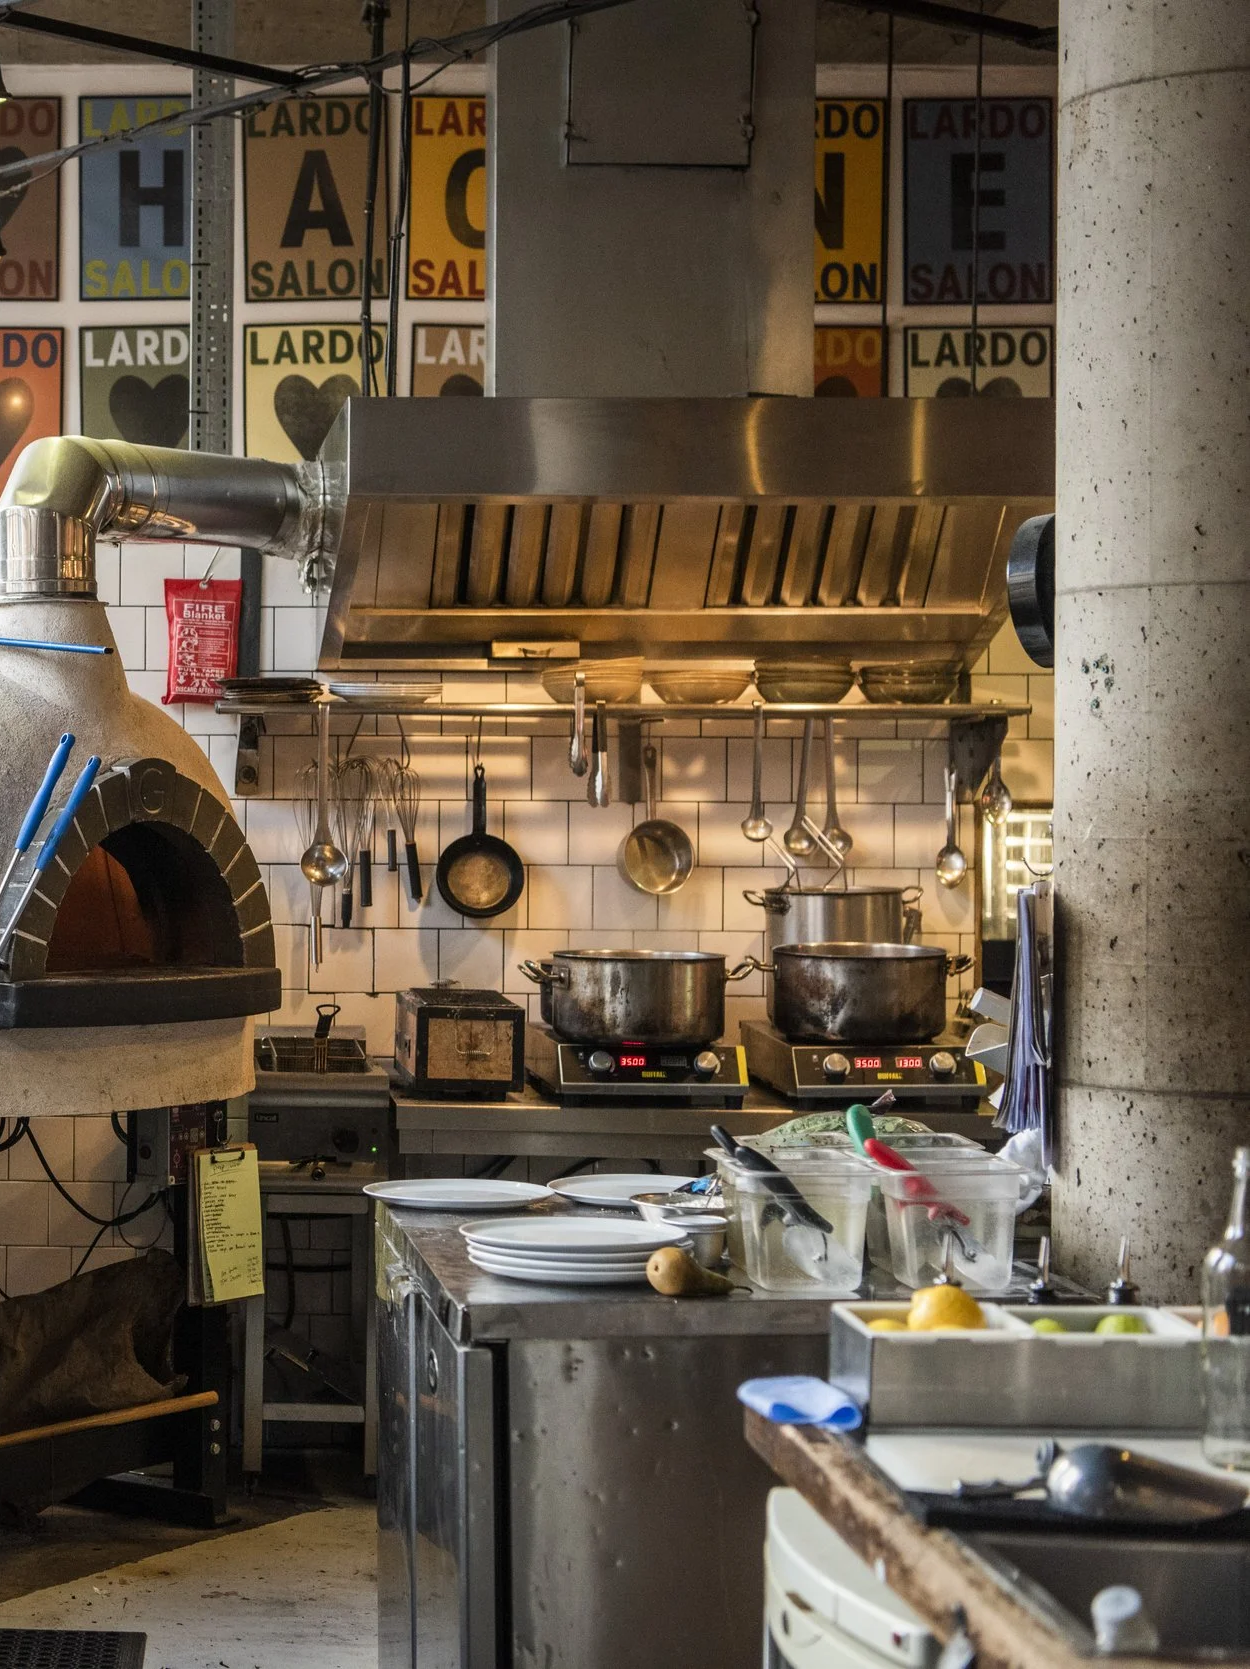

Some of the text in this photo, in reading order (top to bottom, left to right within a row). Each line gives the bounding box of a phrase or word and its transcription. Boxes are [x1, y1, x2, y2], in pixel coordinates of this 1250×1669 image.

[84, 100, 187, 138] LARD
[414, 101, 485, 137] LAR
[909, 103, 1046, 140] LARDO
[120, 150, 184, 247] H
[280, 149, 354, 248] A
[951, 153, 1006, 250] E
[84, 259, 190, 298] SALO
[251, 258, 385, 298] SALON
[412, 259, 485, 296] SAL
[910, 263, 1046, 301] SALON
[84, 330, 189, 368] LARD
[250, 329, 384, 366] LARDO
[417, 328, 485, 366] LAR
[910, 331, 1048, 368] LARDO
[183, 603, 226, 614] FIRE
[183, 610, 226, 620] Blanket
[620, 1057, 645, 1066] 3500
[855, 1059, 921, 1068] 3500 1300
